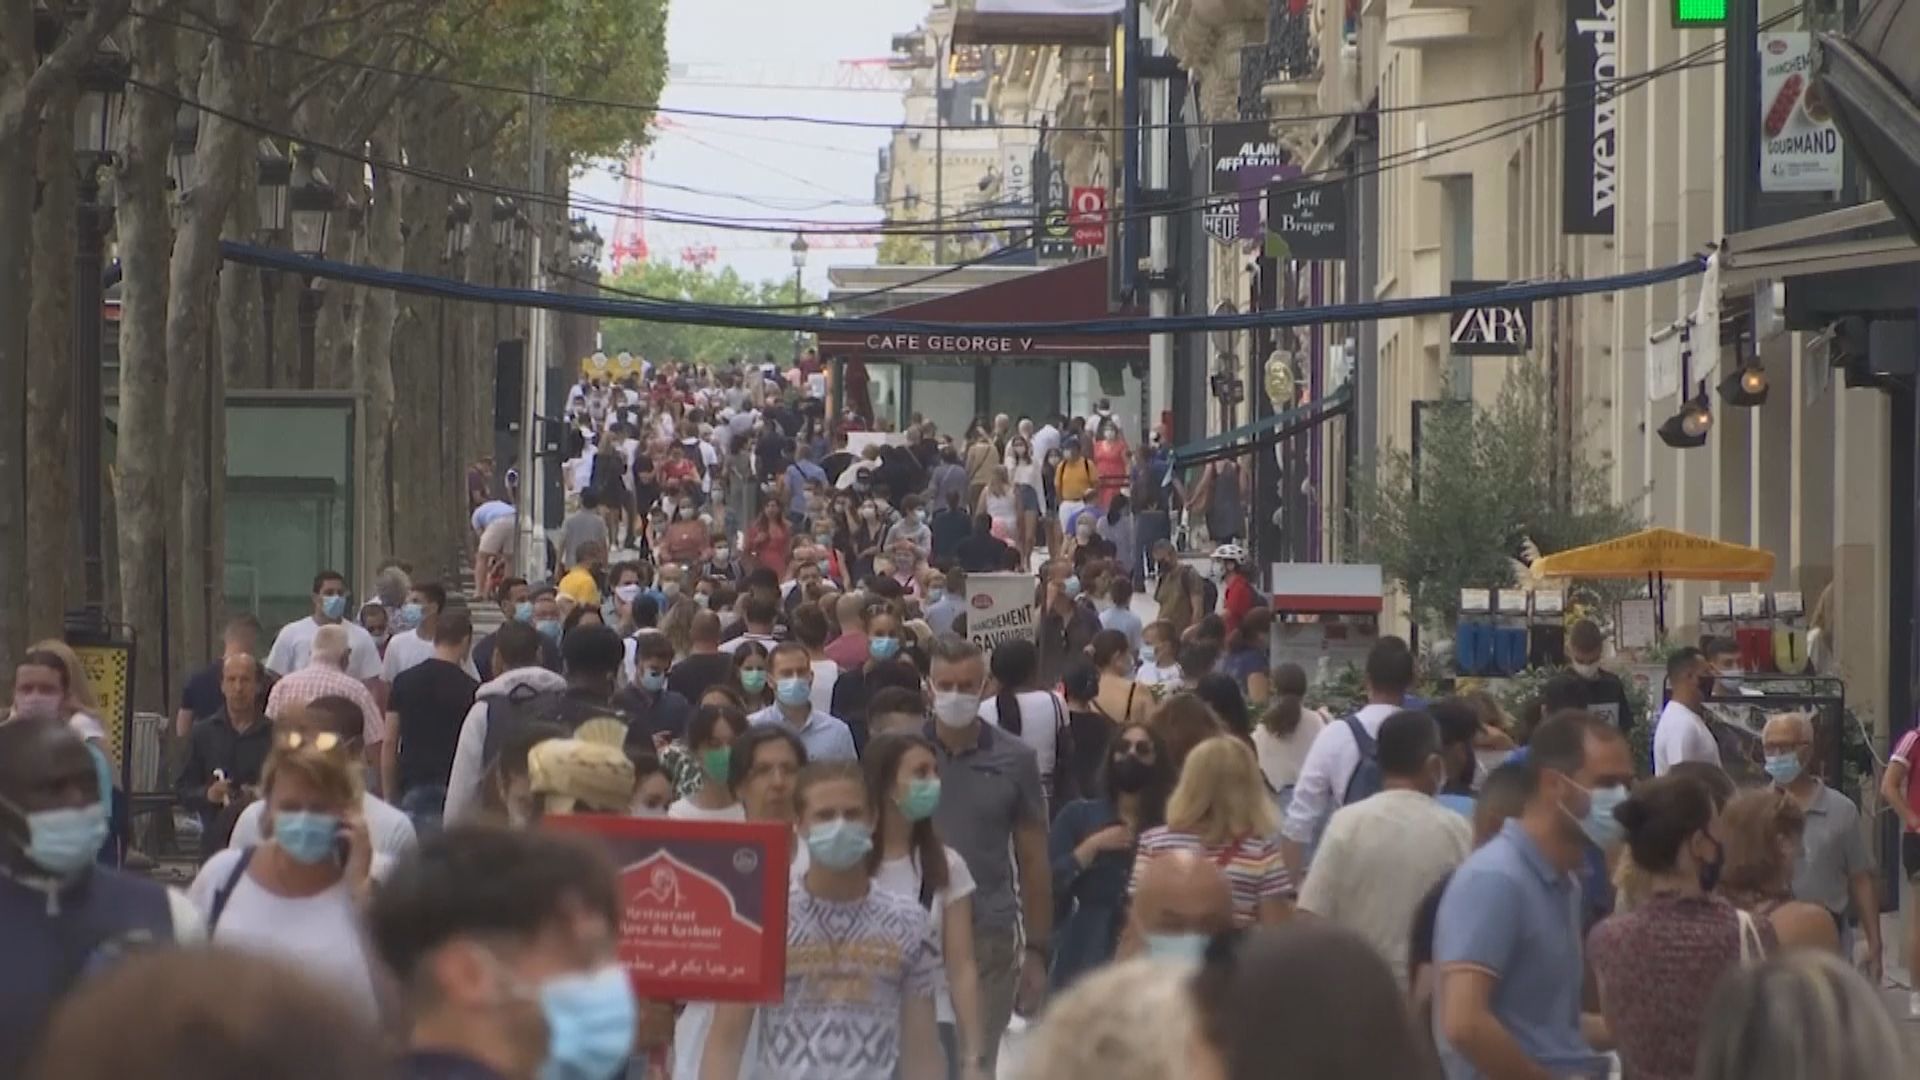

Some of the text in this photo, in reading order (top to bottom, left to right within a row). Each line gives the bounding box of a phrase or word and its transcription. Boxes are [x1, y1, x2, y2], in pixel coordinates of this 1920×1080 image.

[1575, 0, 1615, 217] wework
[1239, 142, 1281, 156] ALAIN
[1767, 128, 1836, 155] GOURMAND
[1207, 199, 1239, 214] TA
[1293, 191, 1321, 209] Jeff
[1301, 209, 1314, 217] de
[1282, 215, 1335, 236] Bruges
[1451, 307, 1527, 344] ZARA
[866, 335, 1033, 351] CAFE GEORGE V
[625, 907, 697, 922] Restaurant
